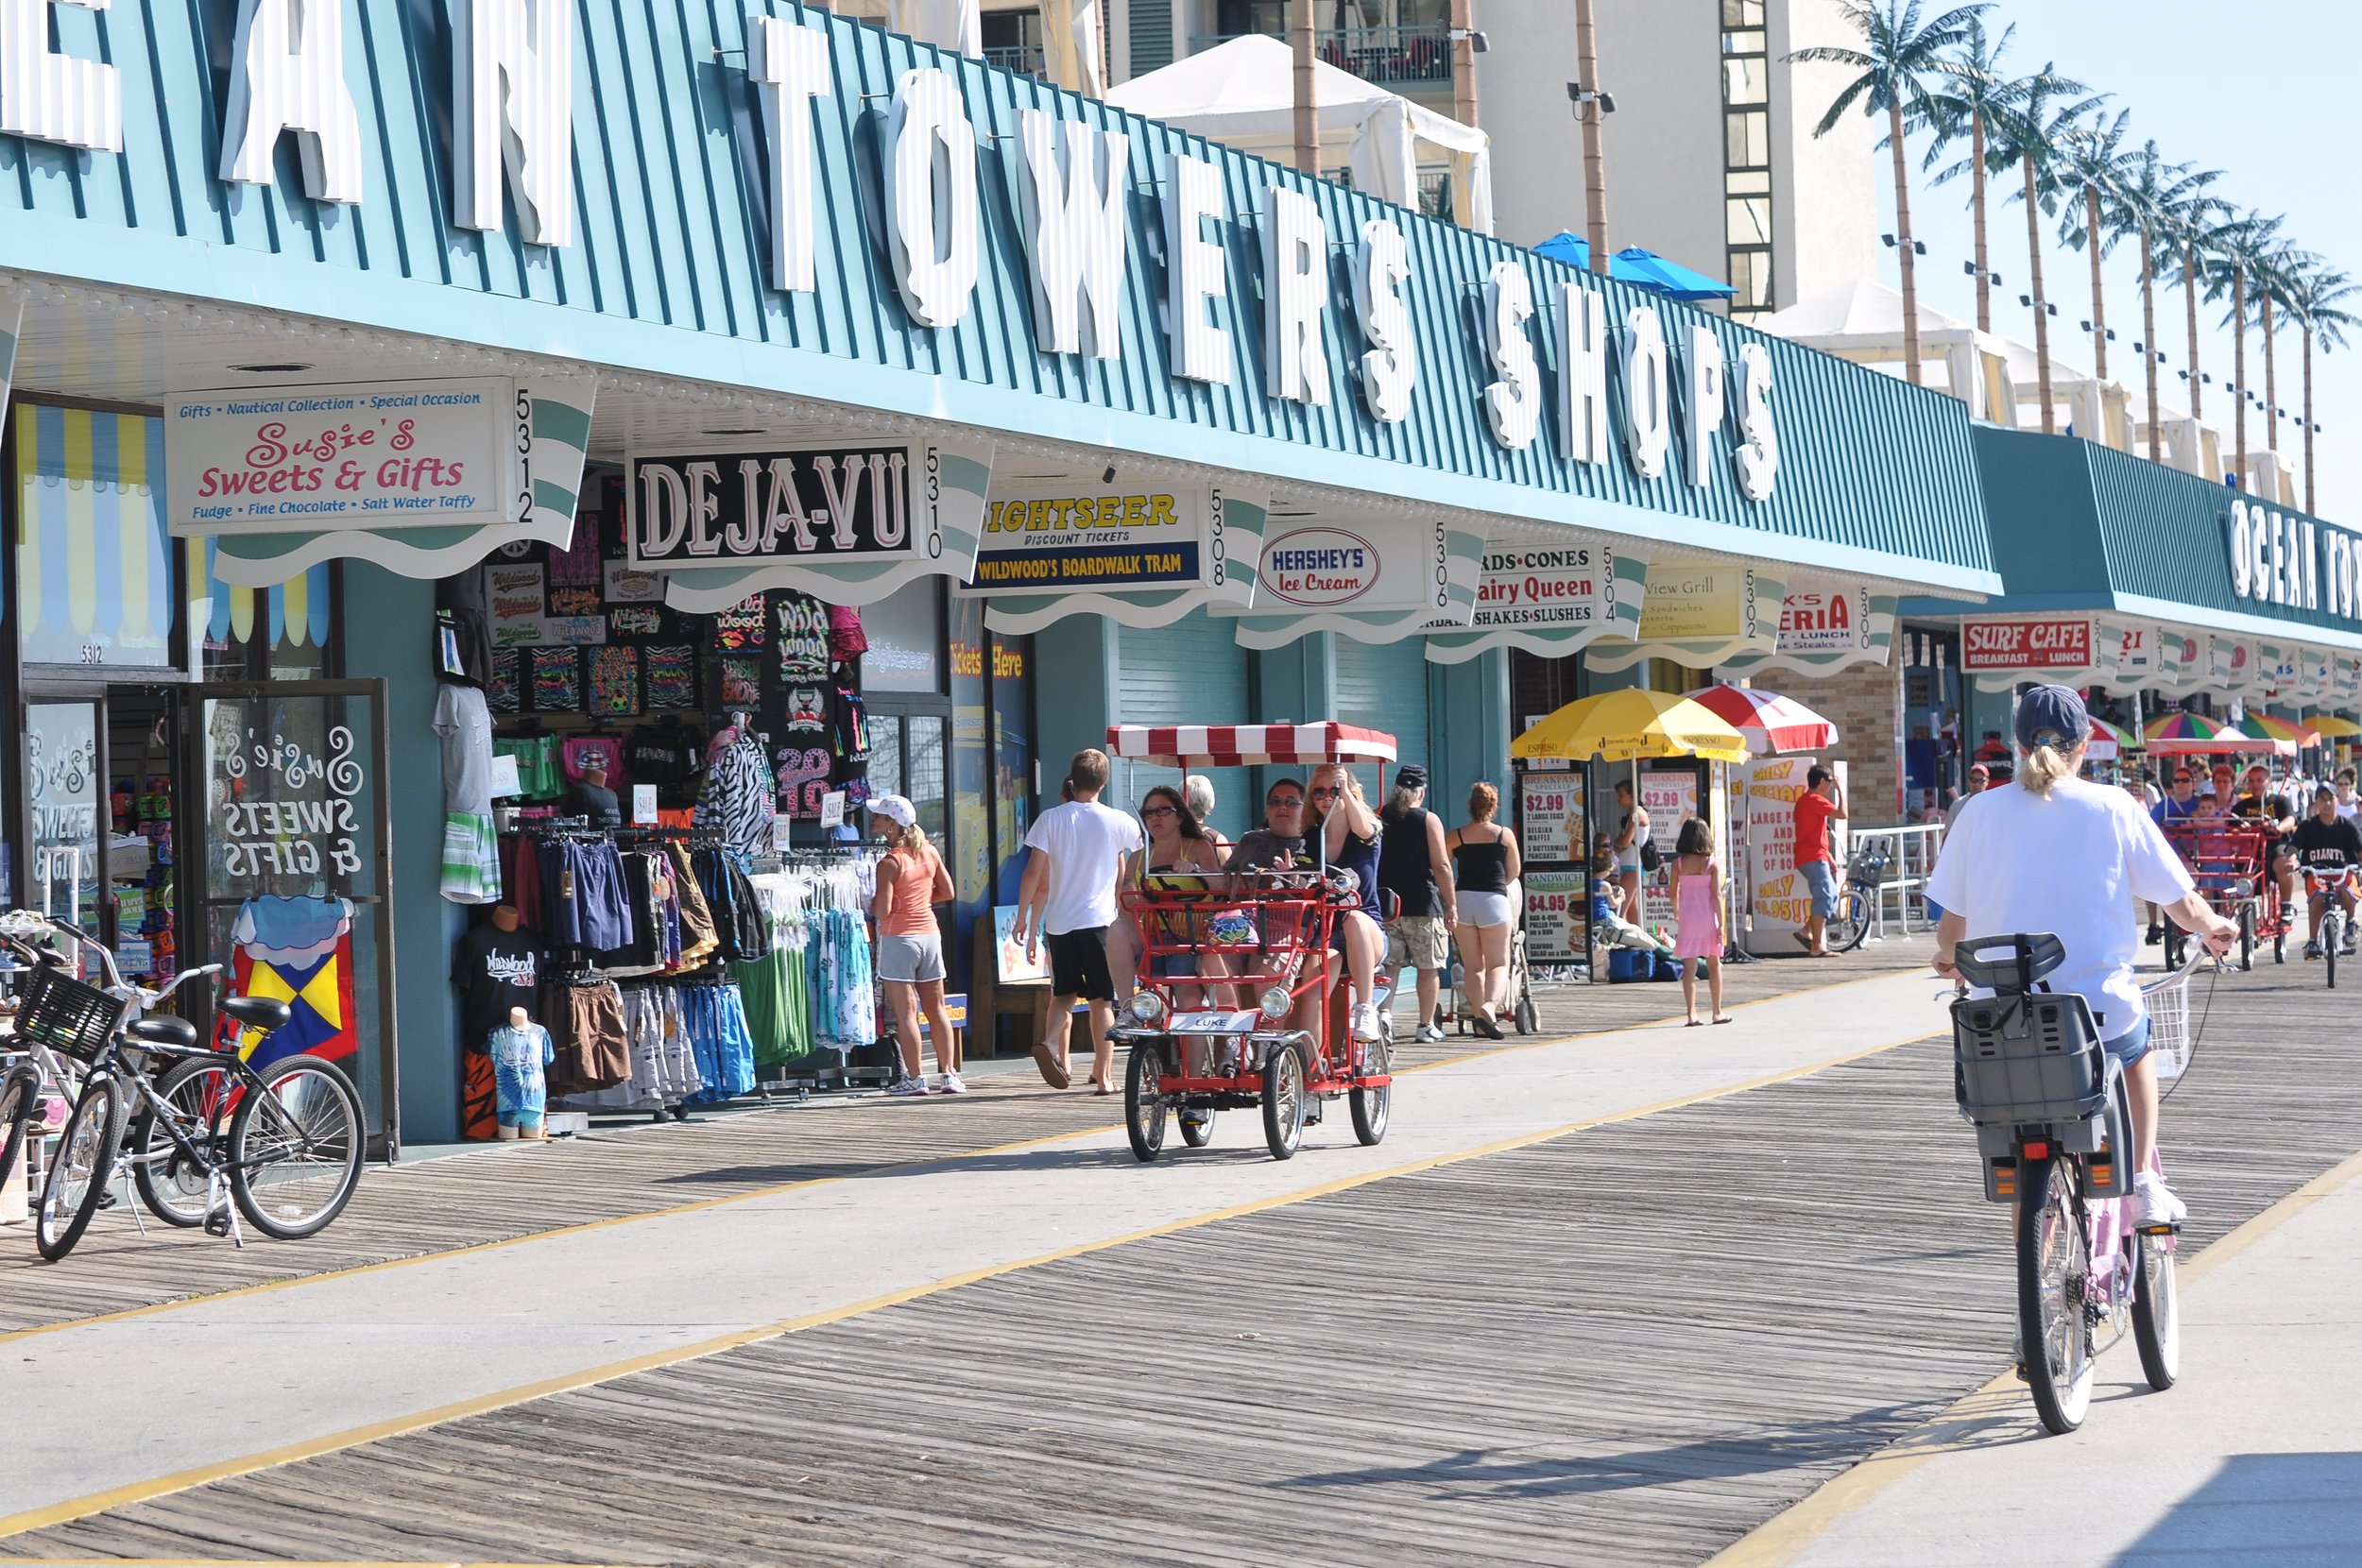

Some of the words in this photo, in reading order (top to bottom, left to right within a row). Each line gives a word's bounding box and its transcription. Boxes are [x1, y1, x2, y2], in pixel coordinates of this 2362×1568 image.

[748, 15, 1414, 424] TOWERS
[1485, 262, 1777, 502] SHOPS
[180, 402, 212, 418] Gifts
[227, 400, 284, 417] Nautical
[287, 397, 354, 414] Collection
[369, 393, 419, 411] Special
[421, 391, 481, 406] Occasion
[516, 388, 533, 523] 5312
[198, 463, 323, 498] Sweets
[334, 459, 367, 492] &
[377, 457, 464, 492] Gifts
[192, 503, 233, 520] Fudge
[248, 500, 276, 516] Fine
[279, 497, 347, 514] Chocolate
[361, 496, 388, 510] Salt
[392, 495, 436, 510] Water
[438, 493, 476, 510] Taffy
[639, 452, 907, 556] DEJA-VU
[926, 446, 942, 559] 5310
[982, 492, 1179, 533] IGHTSEER
[1024, 533, 1080, 546] DISCOUNT
[1086, 531, 1130, 543] TICKETS
[1210, 488, 1224, 587] 5308
[1273, 548, 1364, 571] HERSHEY'S
[1435, 521, 1447, 607] 5306
[1524, 550, 1589, 568] CONES
[2229, 499, 2318, 610] OCEAN
[978, 559, 1058, 581] WILDWOOD'S
[1061, 554, 1141, 577] BOARDWALK
[1145, 554, 1181, 573] TRAM
[1278, 573, 1302, 591] Ice
[1306, 572, 1361, 590] Cream
[1524, 576, 1592, 603] Queen
[1602, 546, 1616, 622] 5304
[1645, 582, 1678, 594] View
[1683, 576, 1714, 594] Grill
[1475, 609, 1529, 624] SHAKES
[1533, 606, 1591, 622] SLUSHES
[1650, 603, 1703, 614] Sandwiches
[1746, 570, 1756, 639] 5302
[717, 612, 765, 628] wood
[776, 599, 830, 634] Wild
[1860, 586, 1870, 650] 5300
[1967, 625, 2026, 651] SURF
[2029, 623, 2086, 650] CAFE
[81, 644, 103, 664] 5312
[992, 640, 1024, 679] Here
[1970, 652, 2028, 665] BREAKFAST
[2048, 651, 2084, 662] LUNCH
[1524, 775, 1581, 785] BREAKFAST
[1753, 759, 1794, 782] DAILY
[1526, 793, 1564, 812] $2.99
[1644, 792, 1679, 808] $2.99
[1751, 812, 1782, 825] LARGE
[1773, 827, 1792, 839] AND
[52, 844, 94, 880] GITS
[1764, 859, 1776, 871] OF
[2309, 847, 2346, 863] GIANTS
[1527, 873, 1583, 883] SANDWICH
[1758, 875, 1794, 898] ONLY
[1529, 894, 1566, 912] $4.95
[1195, 1016, 1227, 1028] LUKE
